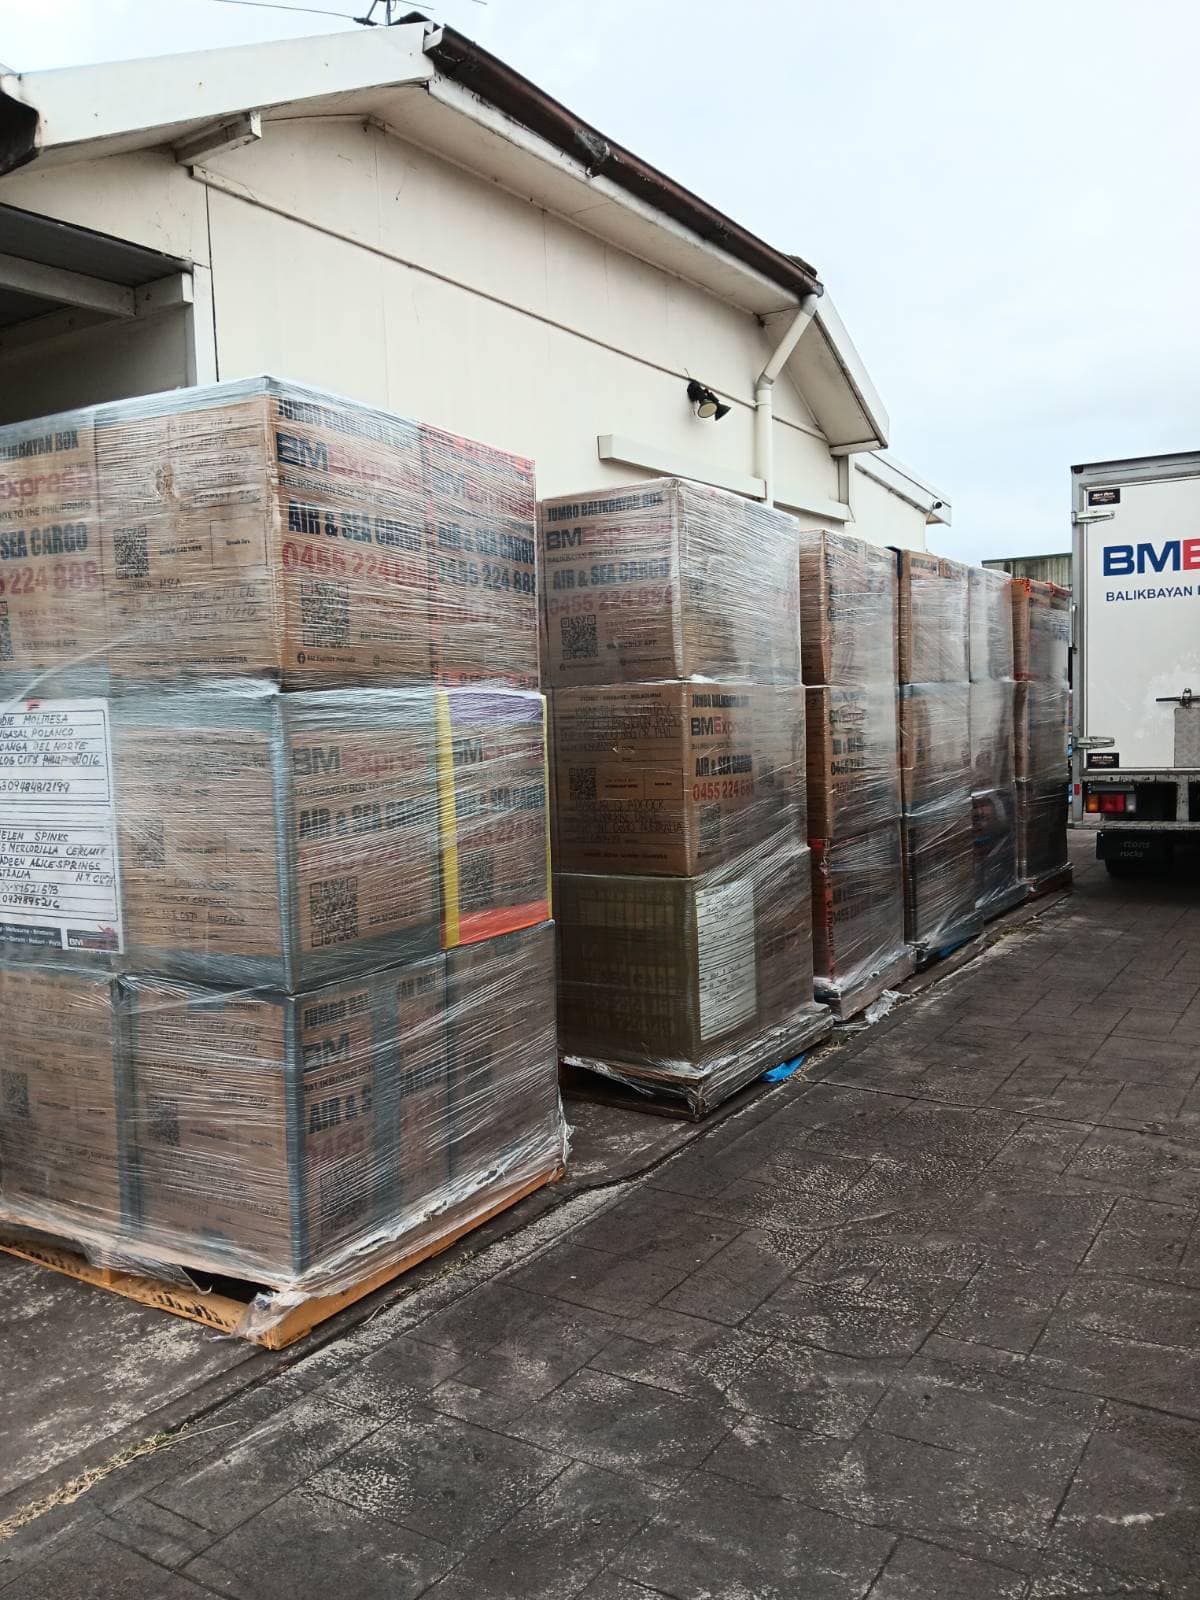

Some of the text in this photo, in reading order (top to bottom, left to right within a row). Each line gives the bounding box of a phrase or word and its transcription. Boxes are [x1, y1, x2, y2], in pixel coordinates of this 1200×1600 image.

[55, 431, 78, 450] BOX
[25, 507, 40, 517] THE
[288, 500, 321, 535] AIR
[340, 511, 372, 544] SEA
[1, 521, 88, 560] SEA CARGO
[10, 565, 48, 595] 224
[1106, 586, 1193, 602] BALIKBAYAN
[31, 727, 74, 738] POLANCO
[53, 741, 88, 752] NORTE
[693, 782, 720, 801] 0455
[722, 779, 739, 799] 224
[56, 860, 101, 871] SPRINGS
